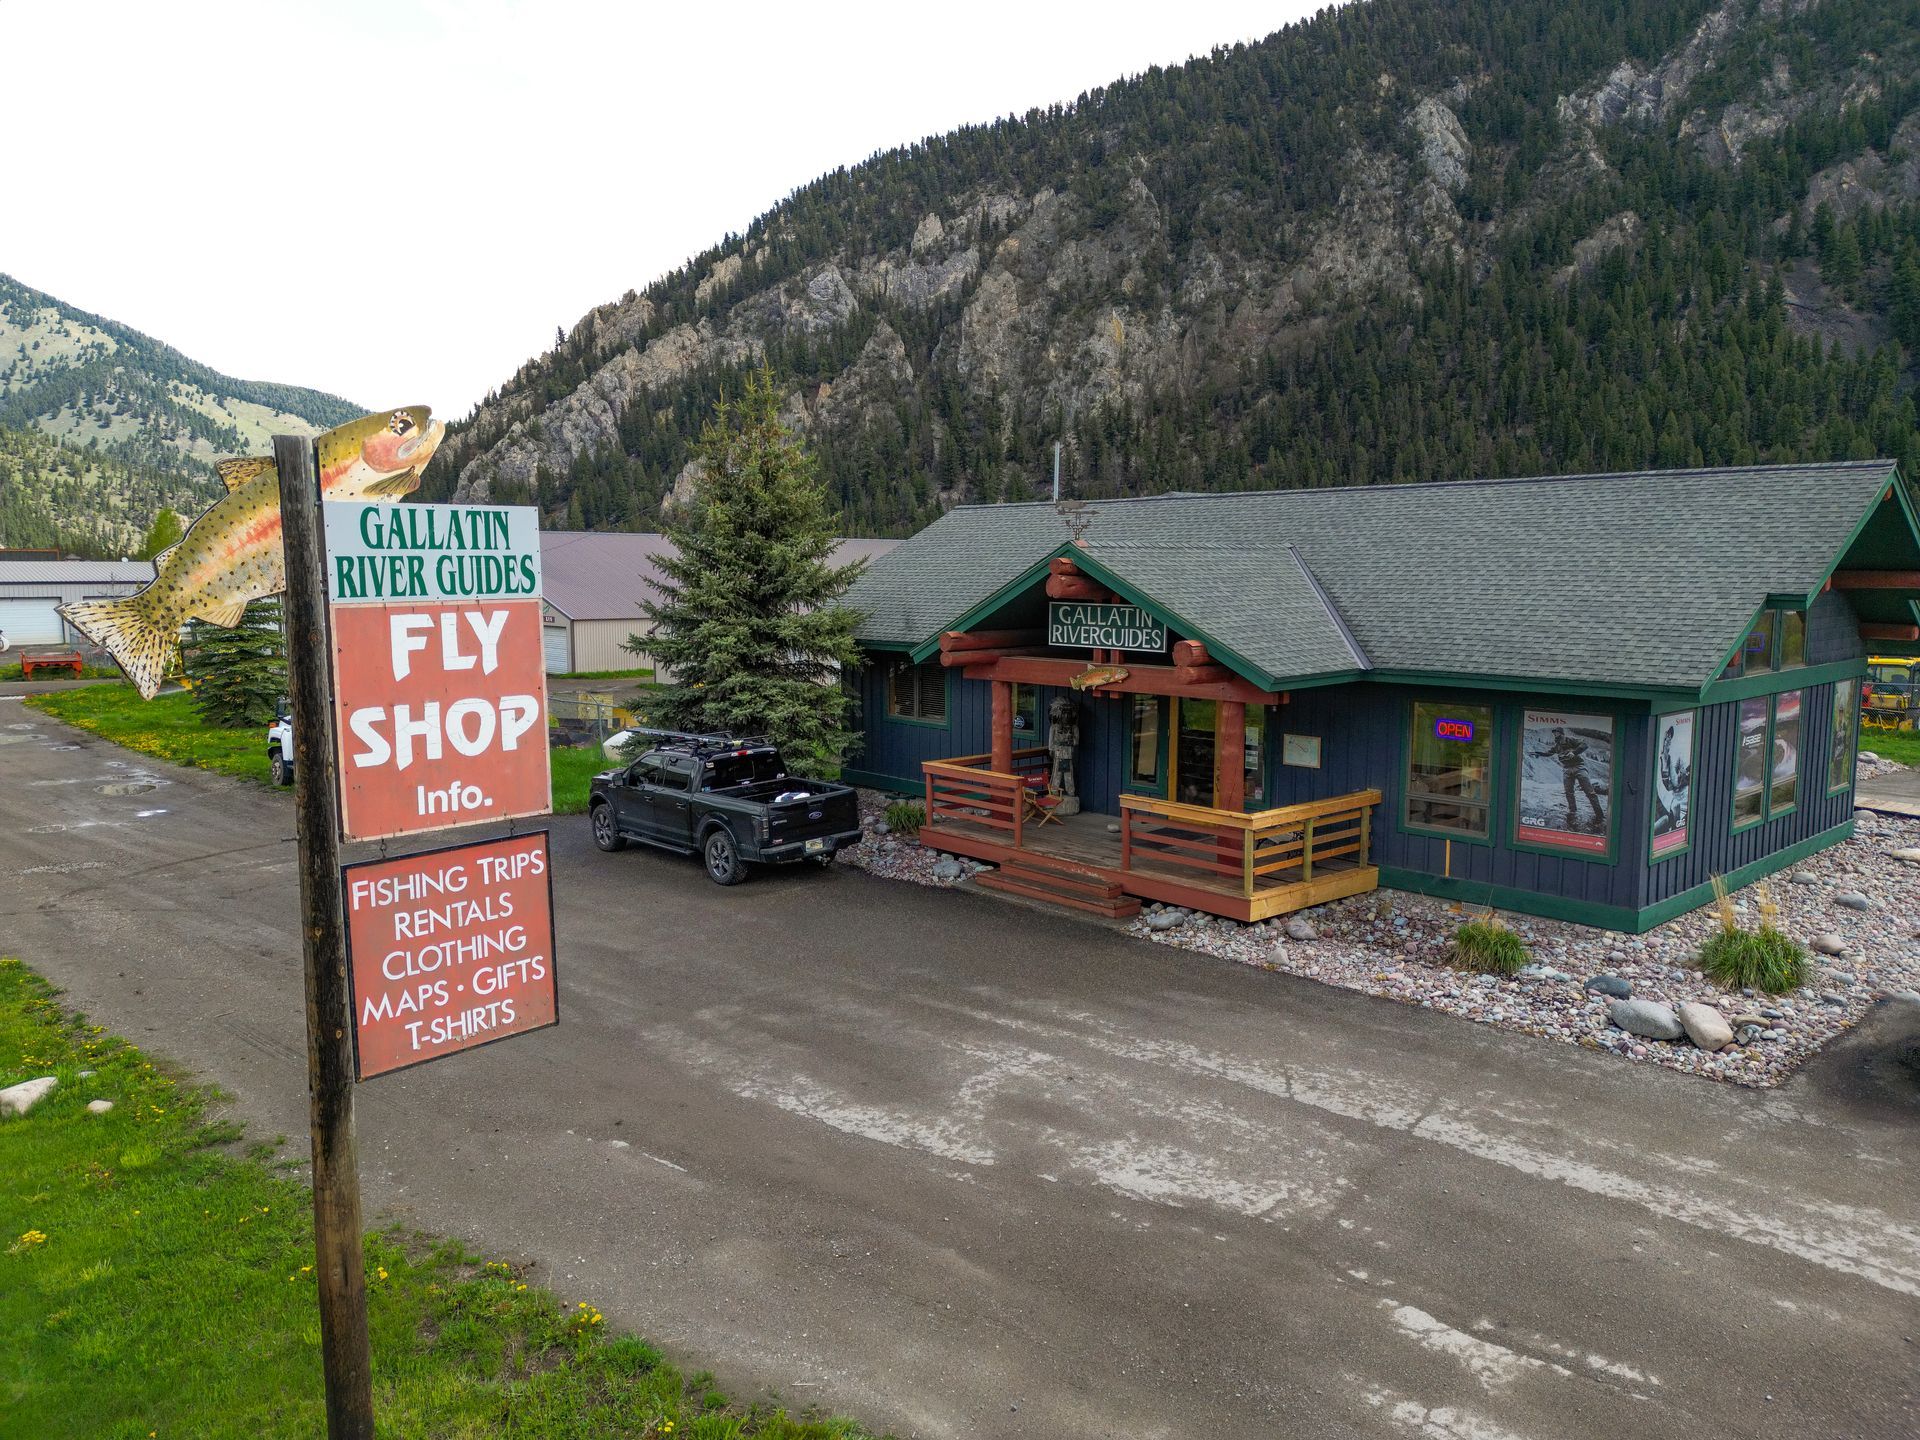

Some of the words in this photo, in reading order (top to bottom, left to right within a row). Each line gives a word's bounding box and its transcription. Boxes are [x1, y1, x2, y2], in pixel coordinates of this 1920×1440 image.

[359, 506, 511, 551] GALLATIN
[335, 555, 429, 599] RIVER
[436, 554, 537, 596] GUIDES
[1058, 606, 1153, 628] GALLATIN
[389, 610, 509, 682] FLY
[350, 695, 539, 771] SHOP
[1438, 722, 1471, 738] OPEN
[1527, 714, 1567, 725] SIMMS
[417, 780, 493, 815] Info.
[1521, 816, 1545, 827] GRG
[352, 866, 468, 911] FISHING
[476, 849, 545, 885] TRIPS
[394, 892, 513, 941] RENTALS
[382, 925, 527, 980] CLOTHING
[362, 980, 449, 1026] MAPS
[472, 955, 546, 995] GIFTS
[404, 999, 516, 1050] T-SHIRTS
